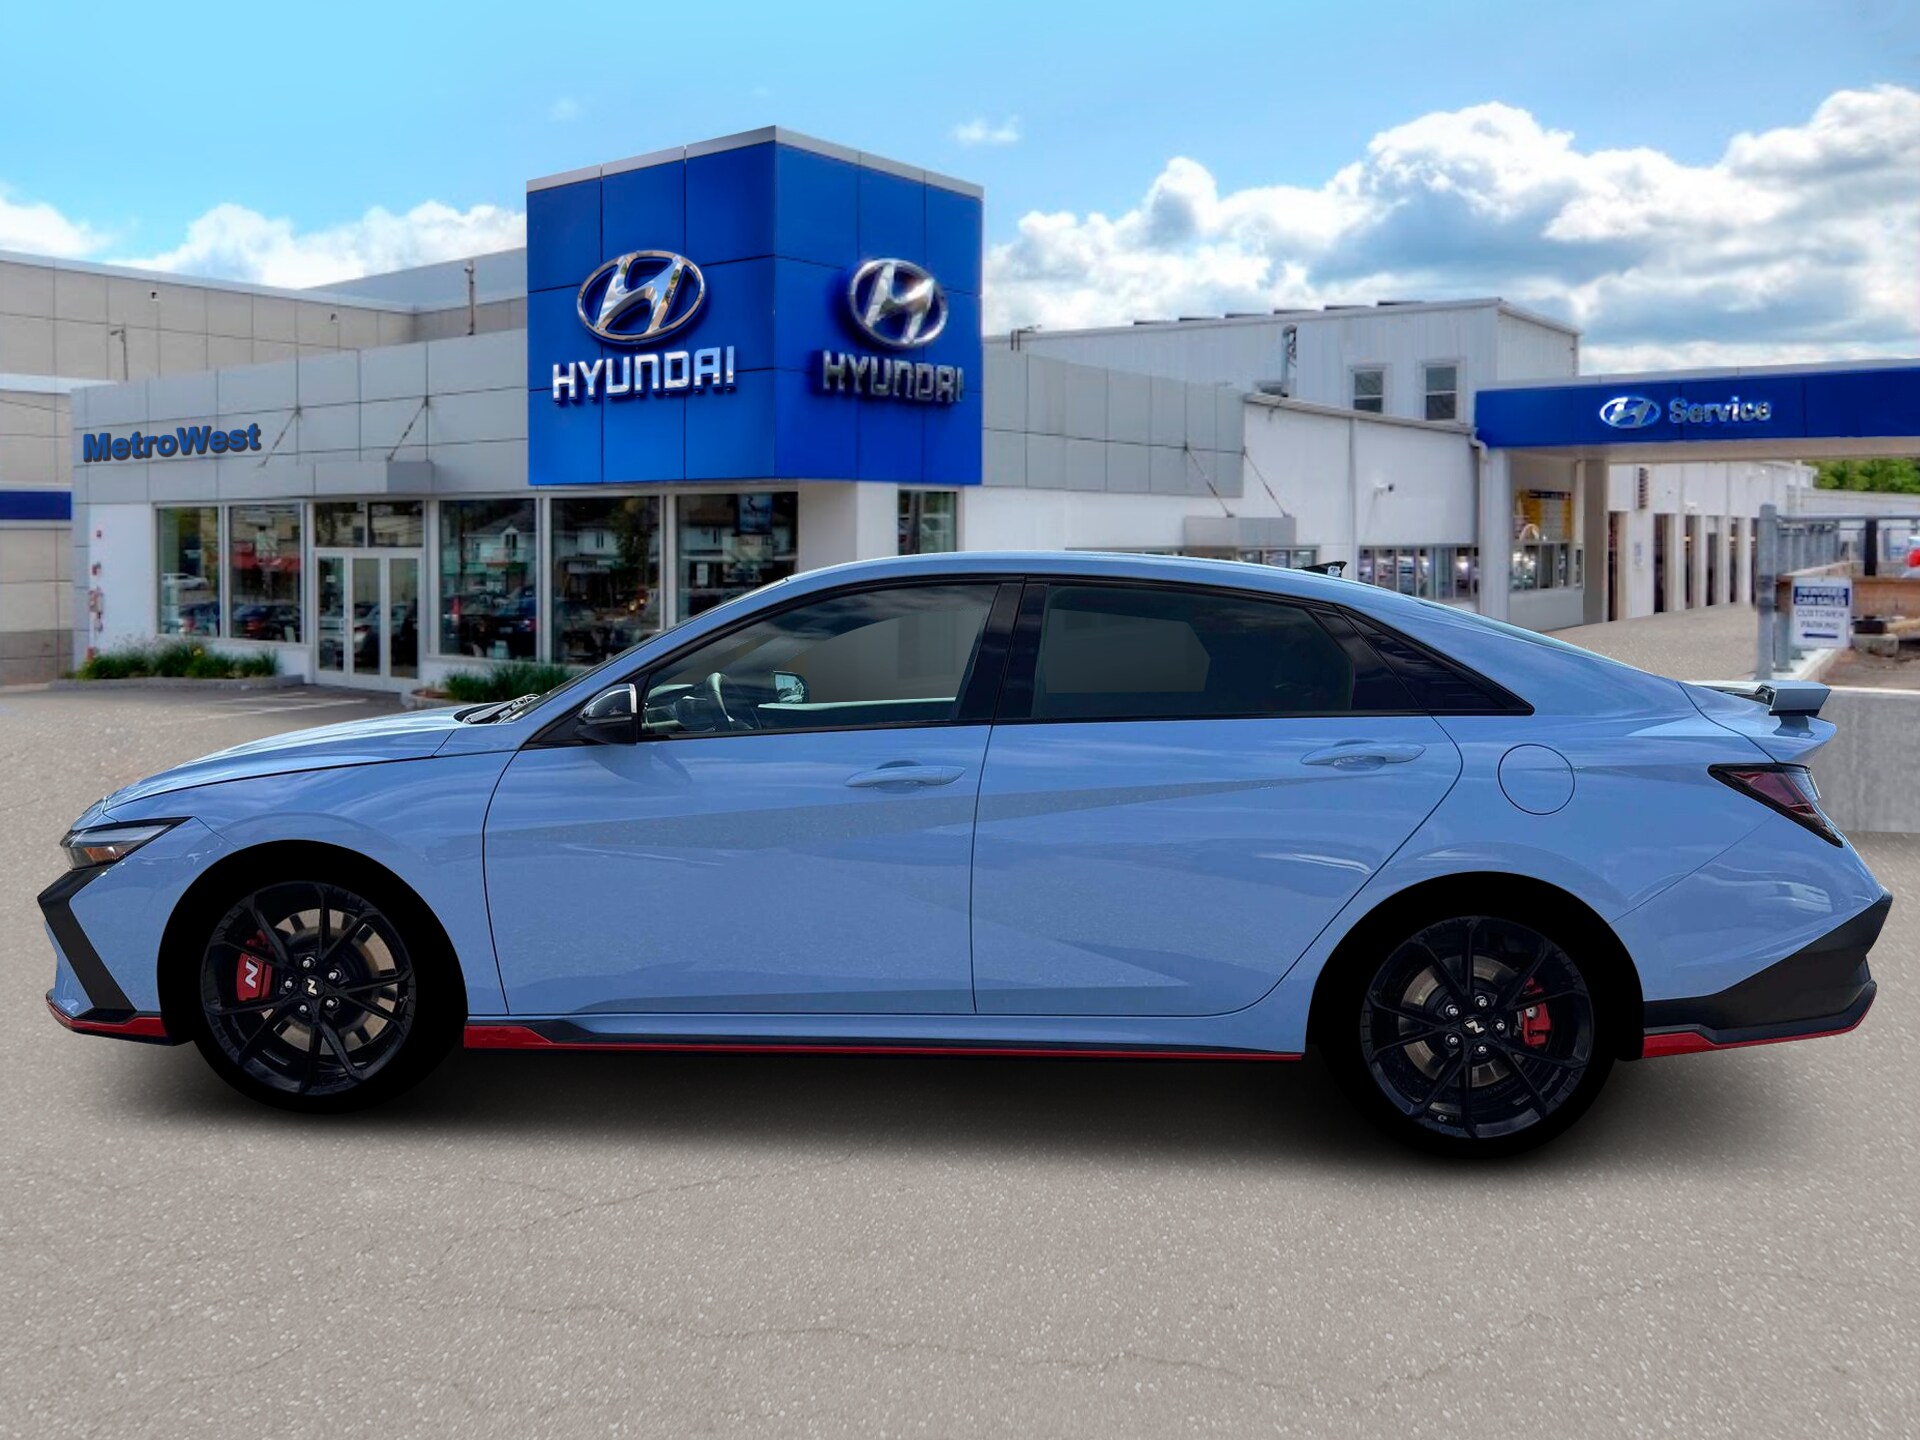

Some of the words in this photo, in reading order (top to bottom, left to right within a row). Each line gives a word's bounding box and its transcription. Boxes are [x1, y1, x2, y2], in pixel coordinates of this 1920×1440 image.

[552, 345, 736, 403] HYUNDAI
[822, 349, 965, 404] HYUNDAI
[1668, 396, 1772, 425] Service
[83, 423, 262, 462] MetroWest
